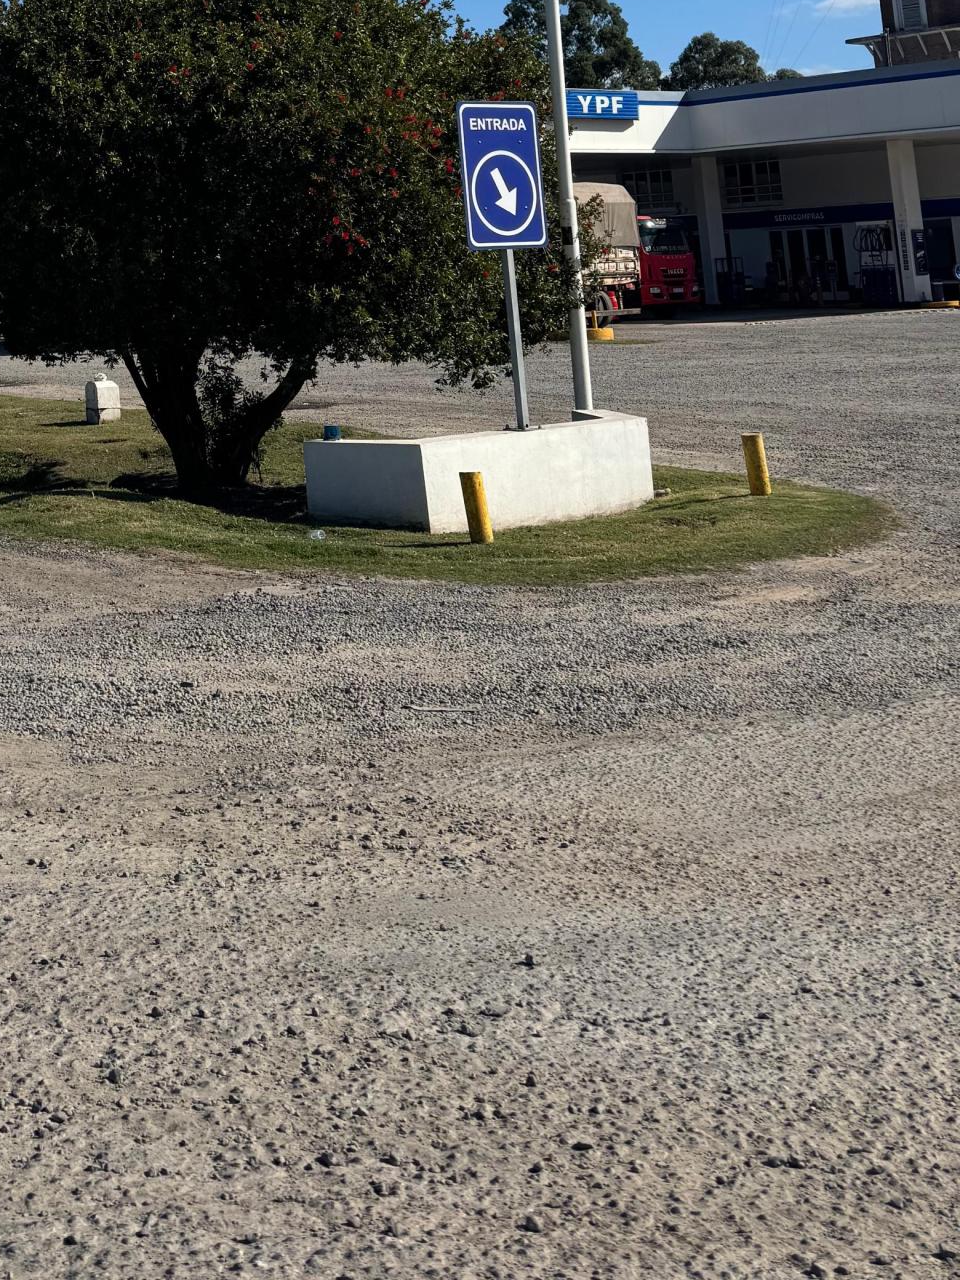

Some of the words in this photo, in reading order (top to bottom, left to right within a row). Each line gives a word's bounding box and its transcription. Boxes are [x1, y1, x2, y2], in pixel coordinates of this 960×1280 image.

[577, 95, 624, 114] YPF
[469, 117, 527, 131] ENTRADA
[774, 211, 825, 222] SERVICOMPRAS
